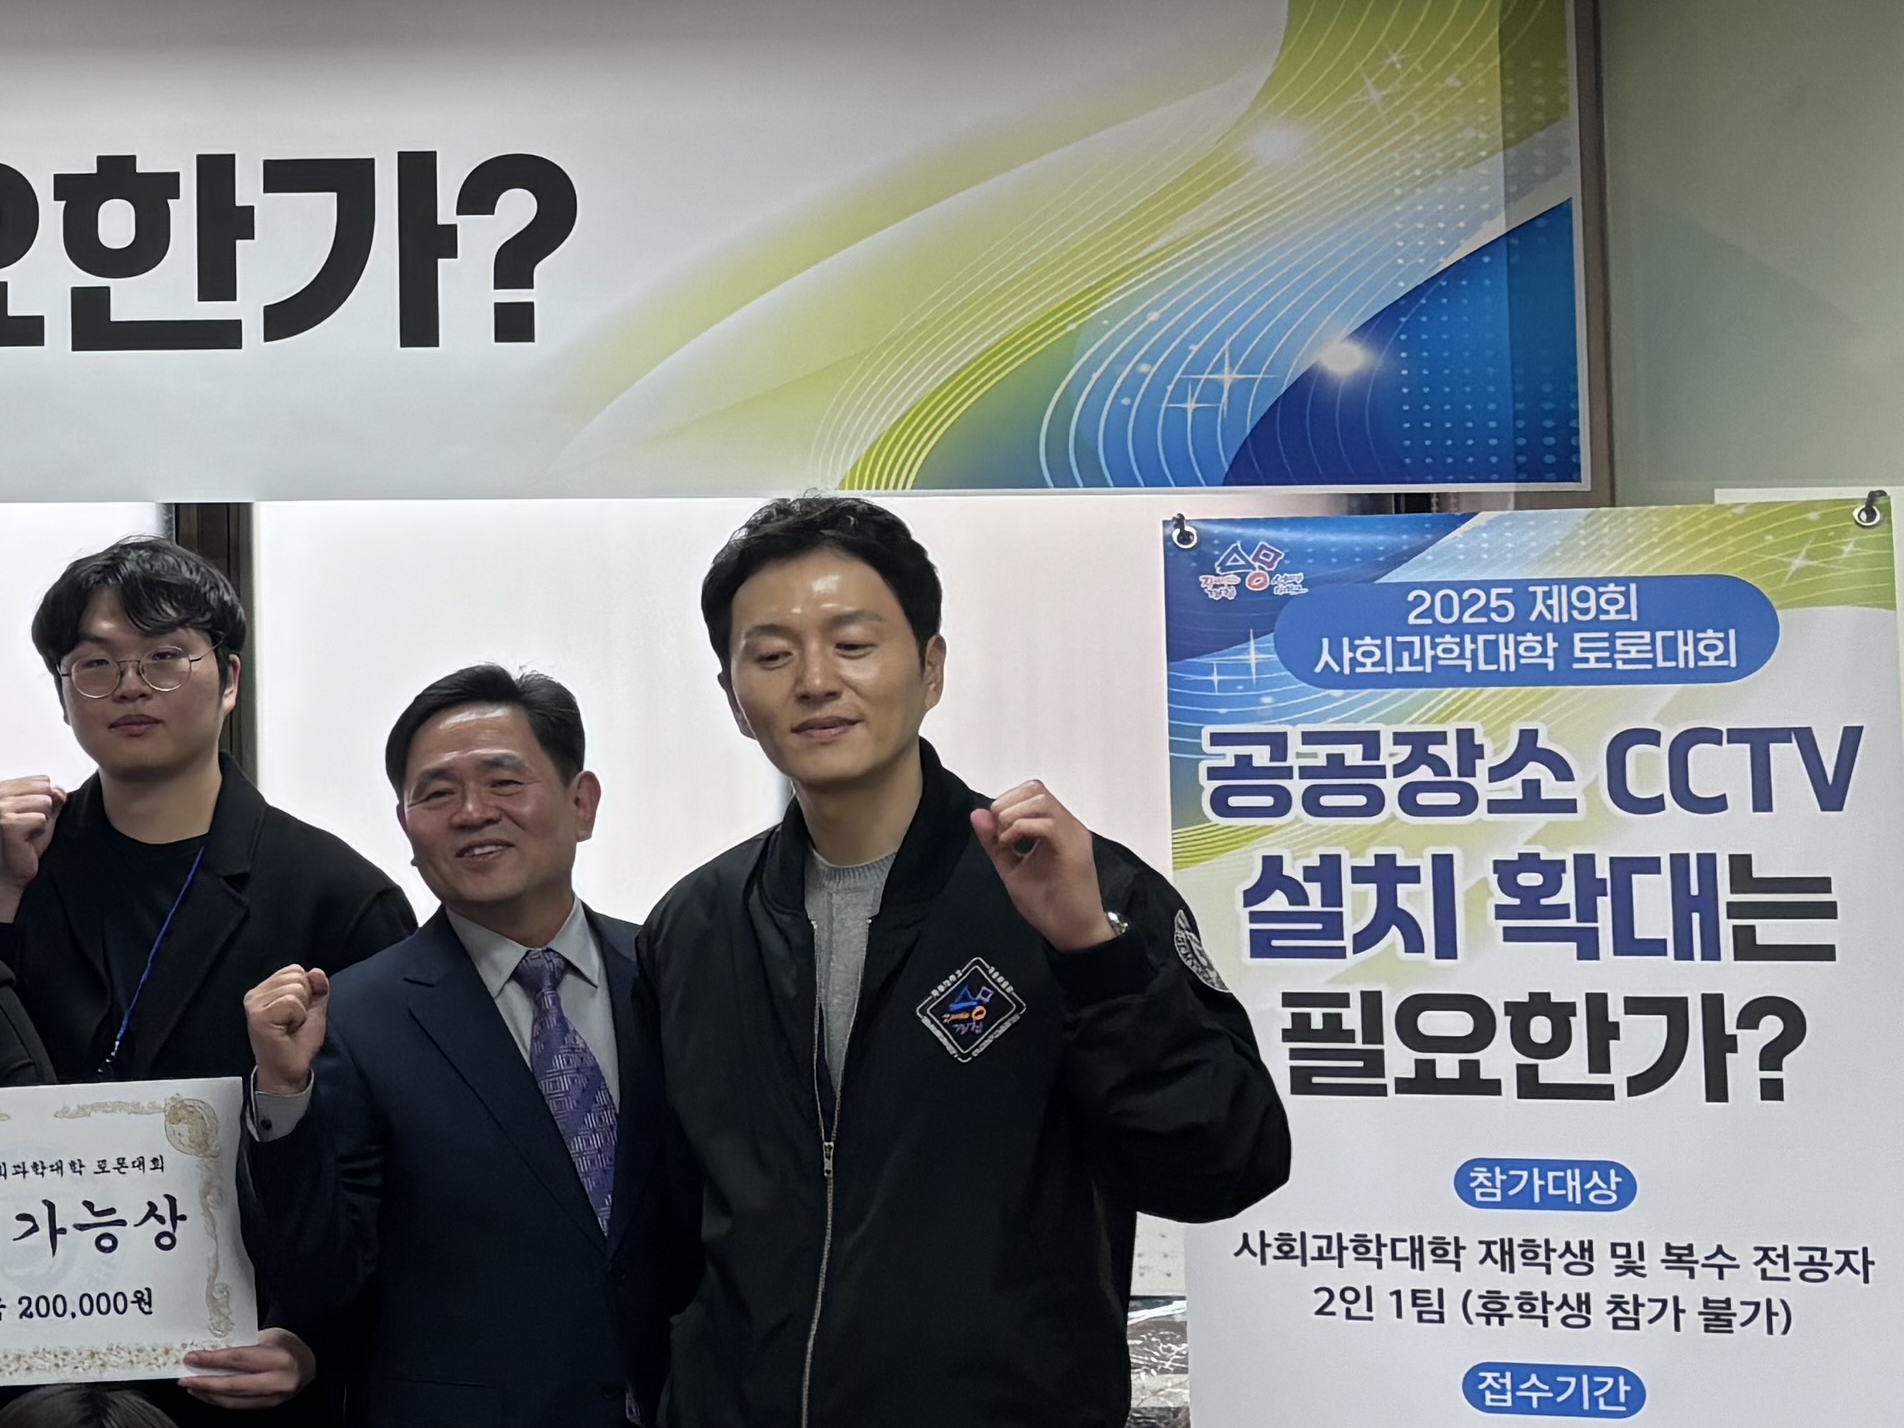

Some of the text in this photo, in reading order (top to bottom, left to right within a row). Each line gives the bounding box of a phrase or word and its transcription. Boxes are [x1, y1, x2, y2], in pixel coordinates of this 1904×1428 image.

[1408, 583, 1637, 624] 2025 제9회
[1314, 629, 1736, 674] 사회과학대학 토론대회
[1199, 726, 1864, 822] 공공장소 CCTV
[1243, 854, 1457, 959] 설치
[1493, 853, 1838, 961] 확대는
[1282, 991, 1806, 1102] 필요한가?
[93, 1155, 164, 1174] 토론대회
[1466, 1167, 1622, 1207] 참가대상
[1234, 1230, 1875, 1284] 사회과학대학 재학생 및 복수 전공자
[18, 1287, 152, 1319] 200,000원
[1314, 1285, 1791, 1335] 2인 1팀 (휴학생 참가 불가)
[1476, 1369, 1632, 1414] 접수기간
